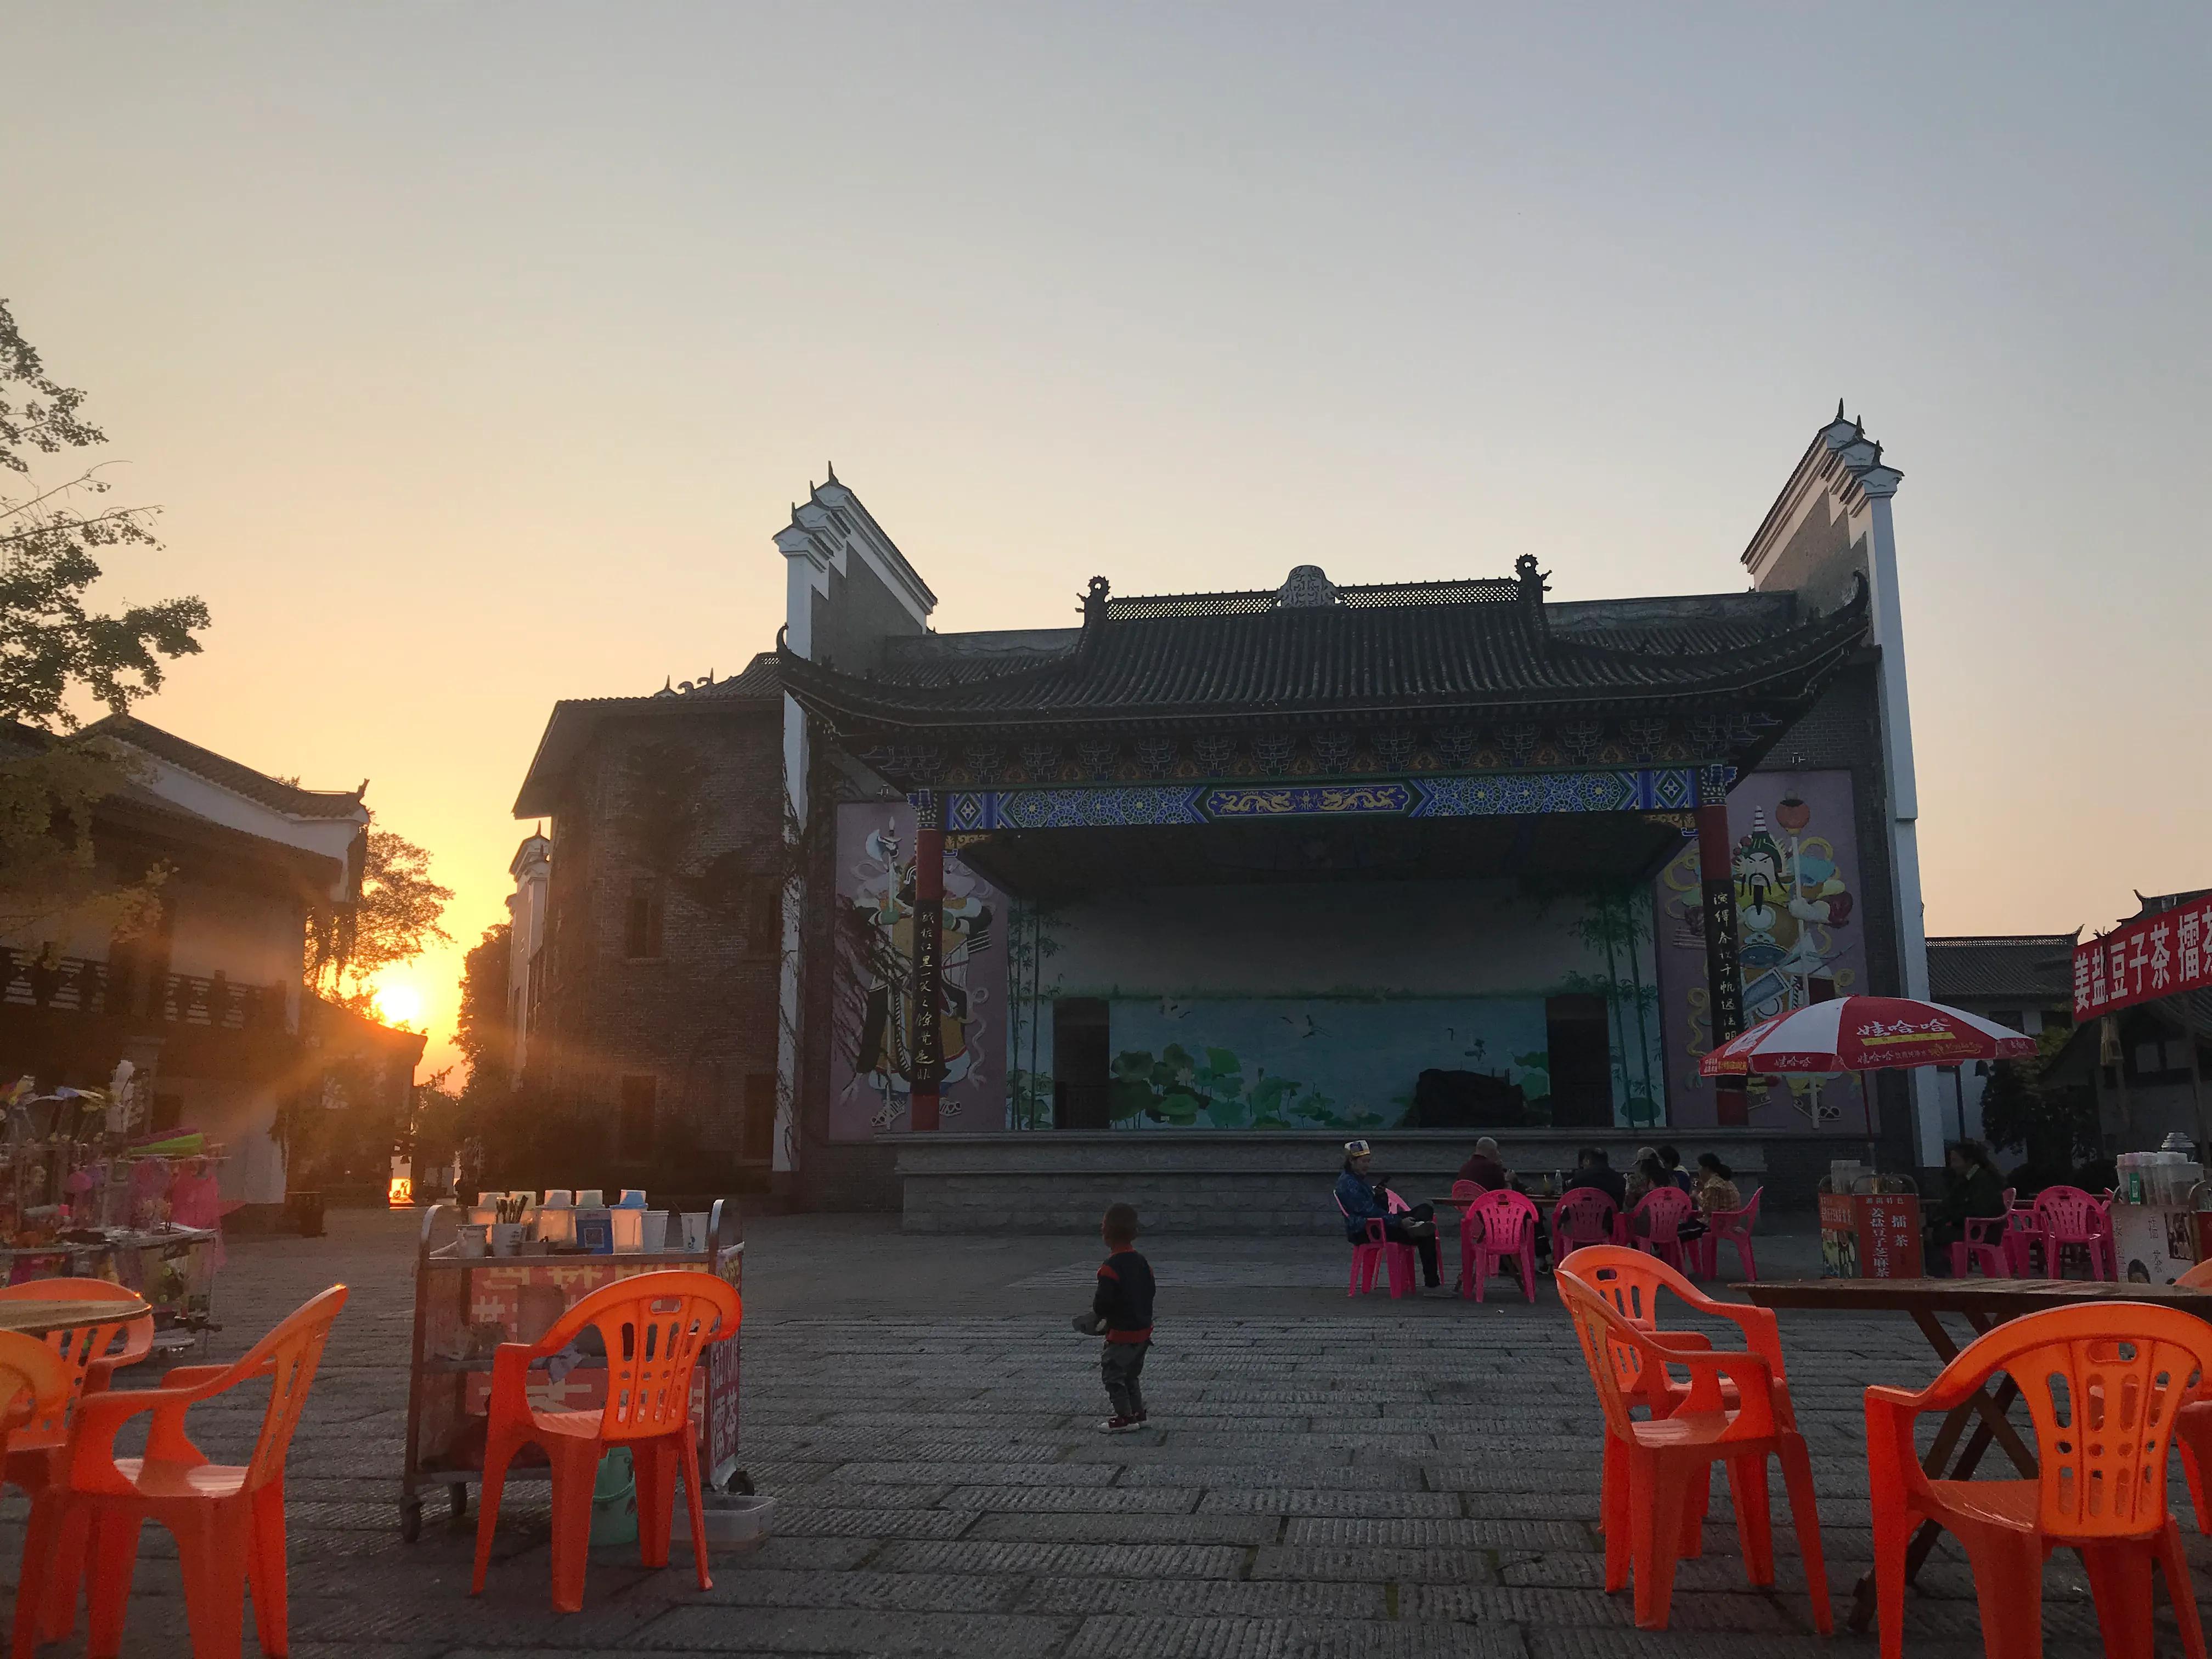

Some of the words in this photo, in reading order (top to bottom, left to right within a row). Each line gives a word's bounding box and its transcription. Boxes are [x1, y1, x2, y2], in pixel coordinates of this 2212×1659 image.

[2074, 921, 2171, 1013] 姜盐豆子茶
[1856, 1018, 1951, 1037] 娃哈哈
[1774, 1054, 1813, 1068] 娃哈哈
[1892, 1215, 1909, 1247] 擂茶
